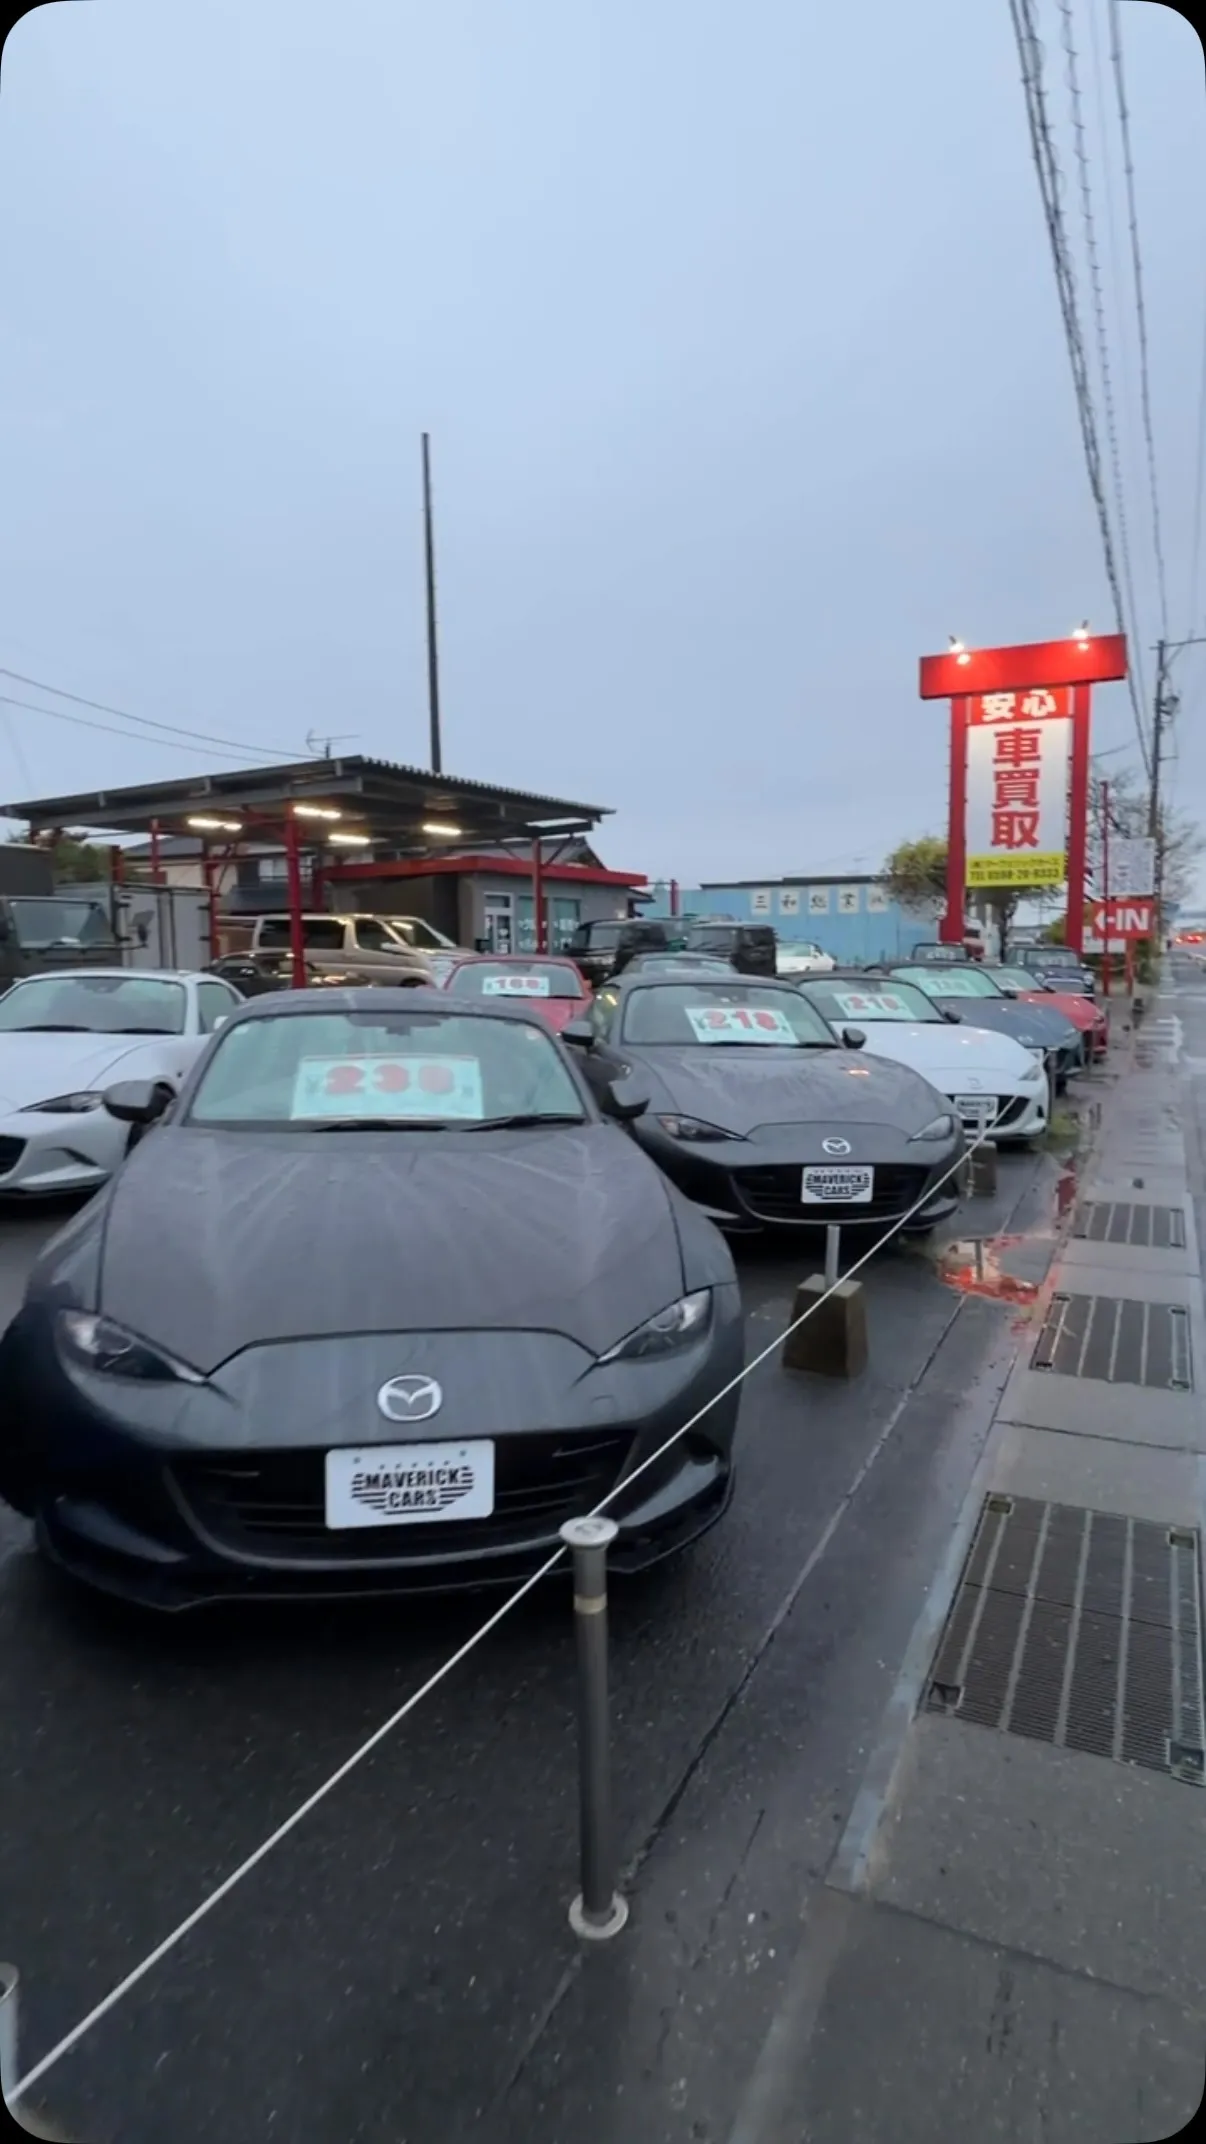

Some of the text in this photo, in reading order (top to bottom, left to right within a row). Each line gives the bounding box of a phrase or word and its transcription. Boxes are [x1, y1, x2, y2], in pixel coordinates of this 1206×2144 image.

[981, 689, 1057, 722] 安心
[991, 728, 1042, 849] 車買取
[1115, 908, 1149, 931] IN
[364, 1467, 460, 1489] MAVERICK
[388, 1489, 438, 1509] CARS
